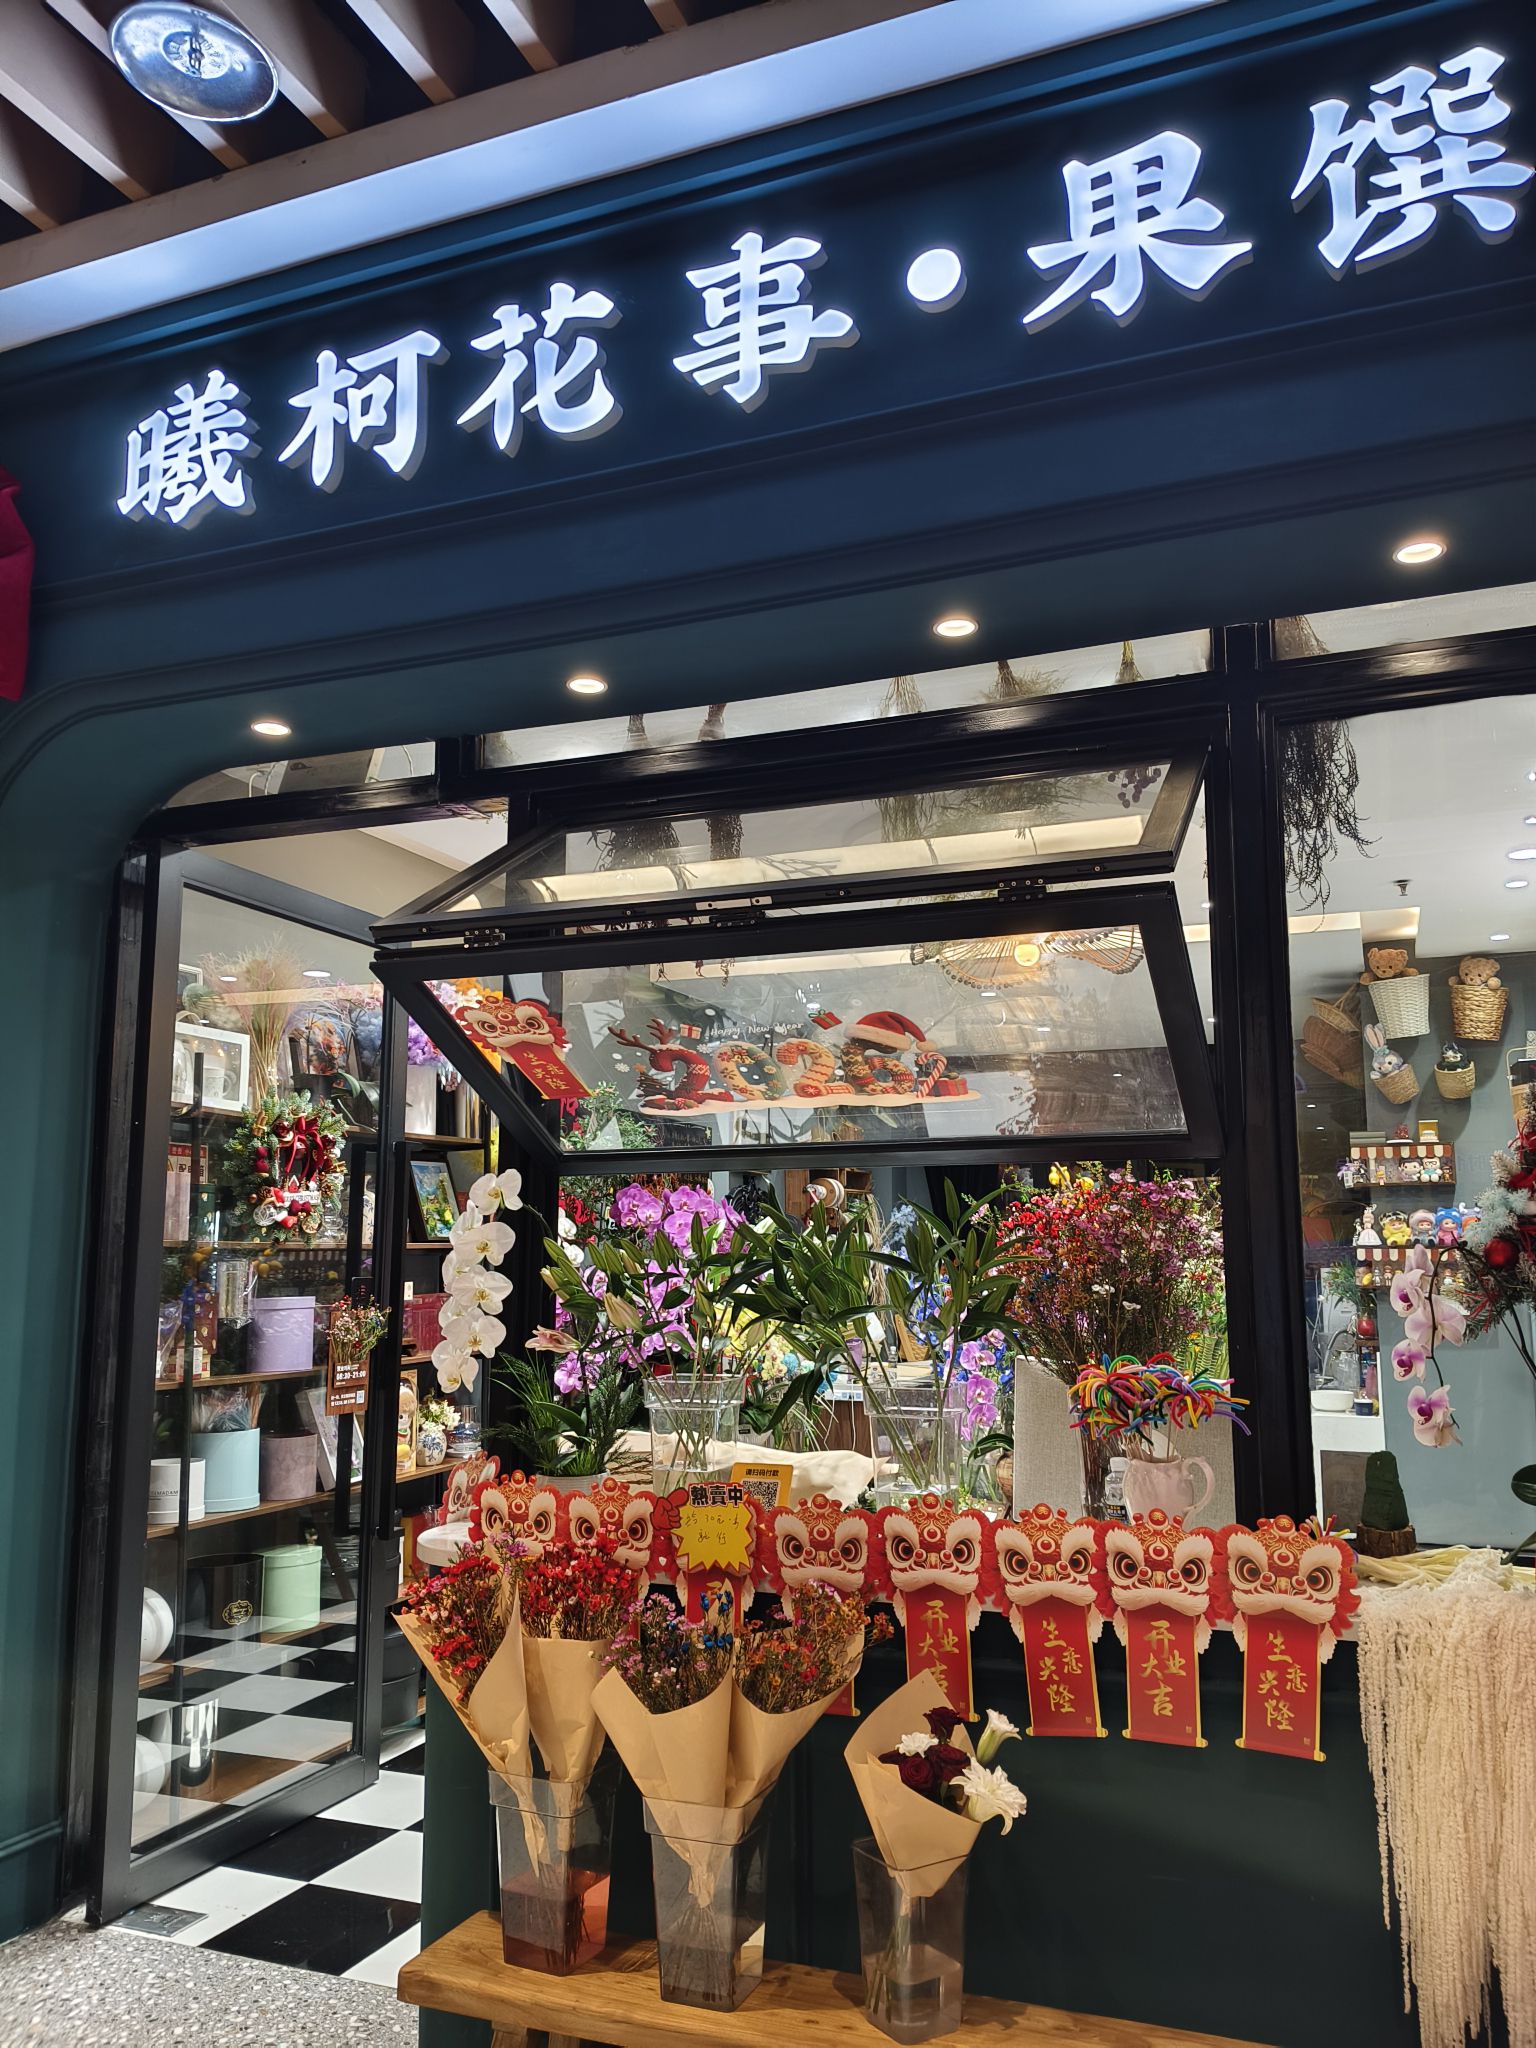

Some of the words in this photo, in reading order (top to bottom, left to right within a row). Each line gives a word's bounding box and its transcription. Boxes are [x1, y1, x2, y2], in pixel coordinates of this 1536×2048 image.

[711, 1027, 740, 1036] Happy
[748, 1025, 769, 1034] New
[691, 1484, 744, 1507] 熱賣中
[1141, 1619, 1187, 1717] 开业大吉
